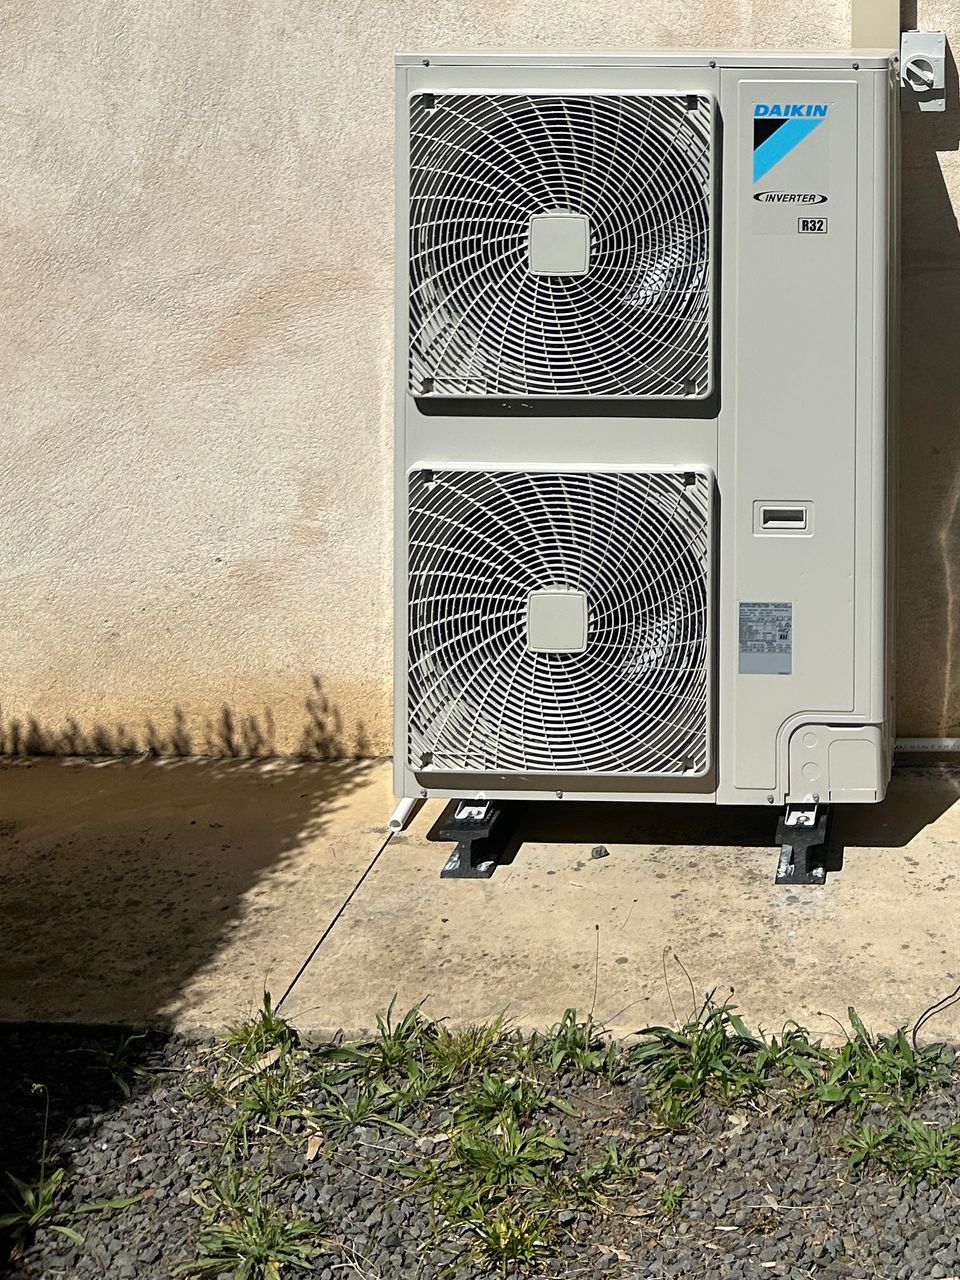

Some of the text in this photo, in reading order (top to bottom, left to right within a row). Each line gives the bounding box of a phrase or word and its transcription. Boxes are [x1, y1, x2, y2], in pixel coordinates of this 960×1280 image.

[753, 104, 828, 117] DAIKIN
[765, 193, 816, 203] INVERTER
[801, 219, 824, 232] R32
